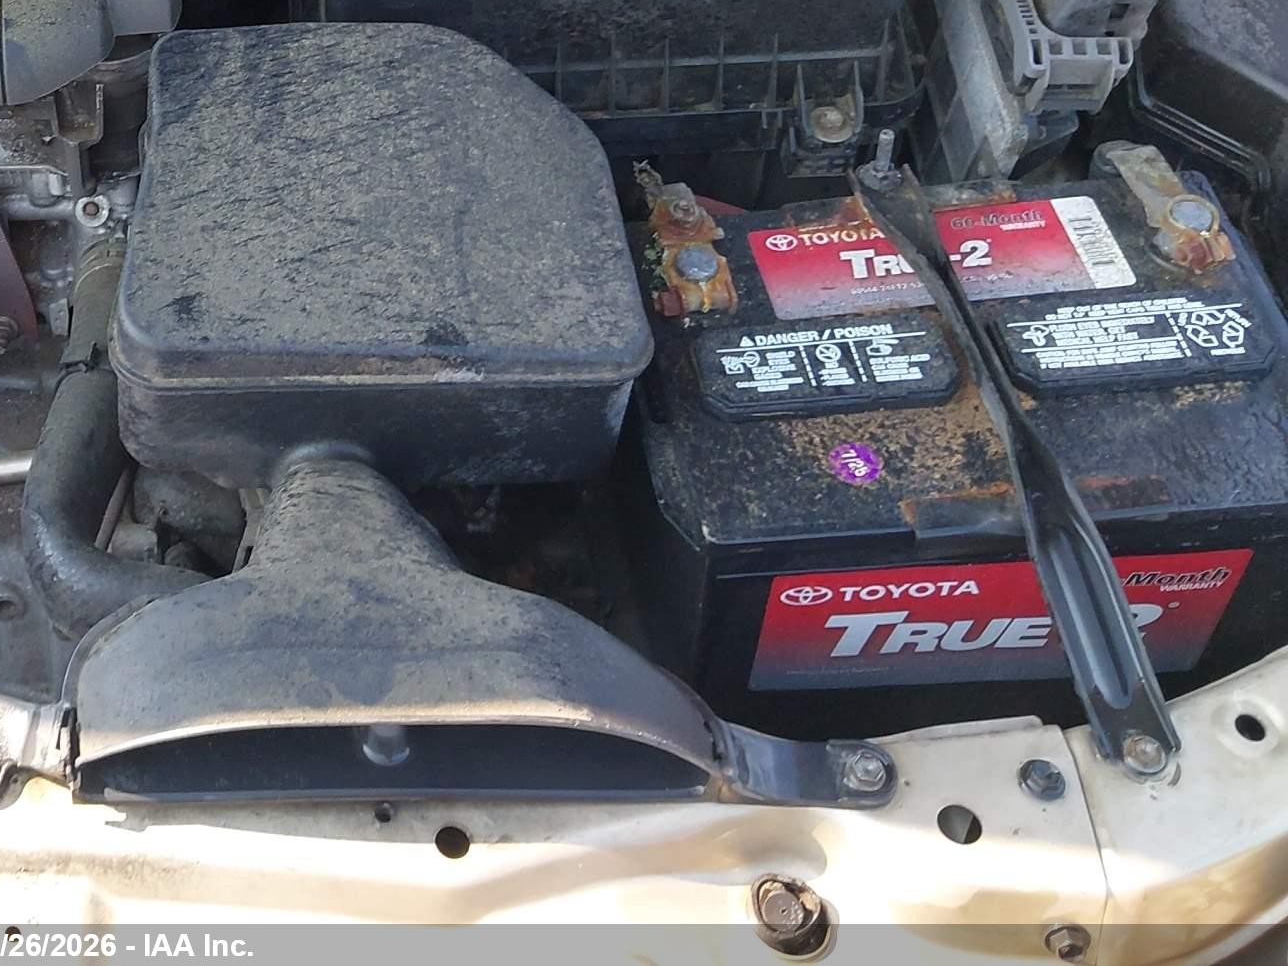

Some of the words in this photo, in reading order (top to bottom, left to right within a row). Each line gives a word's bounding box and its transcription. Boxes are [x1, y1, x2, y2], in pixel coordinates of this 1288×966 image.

[798, 227, 886, 246] TOYOTA
[754, 330, 820, 347] DANGER
[821, 329, 832, 341] /
[833, 323, 894, 340] POISON
[839, 580, 980, 602] TOYOTA
